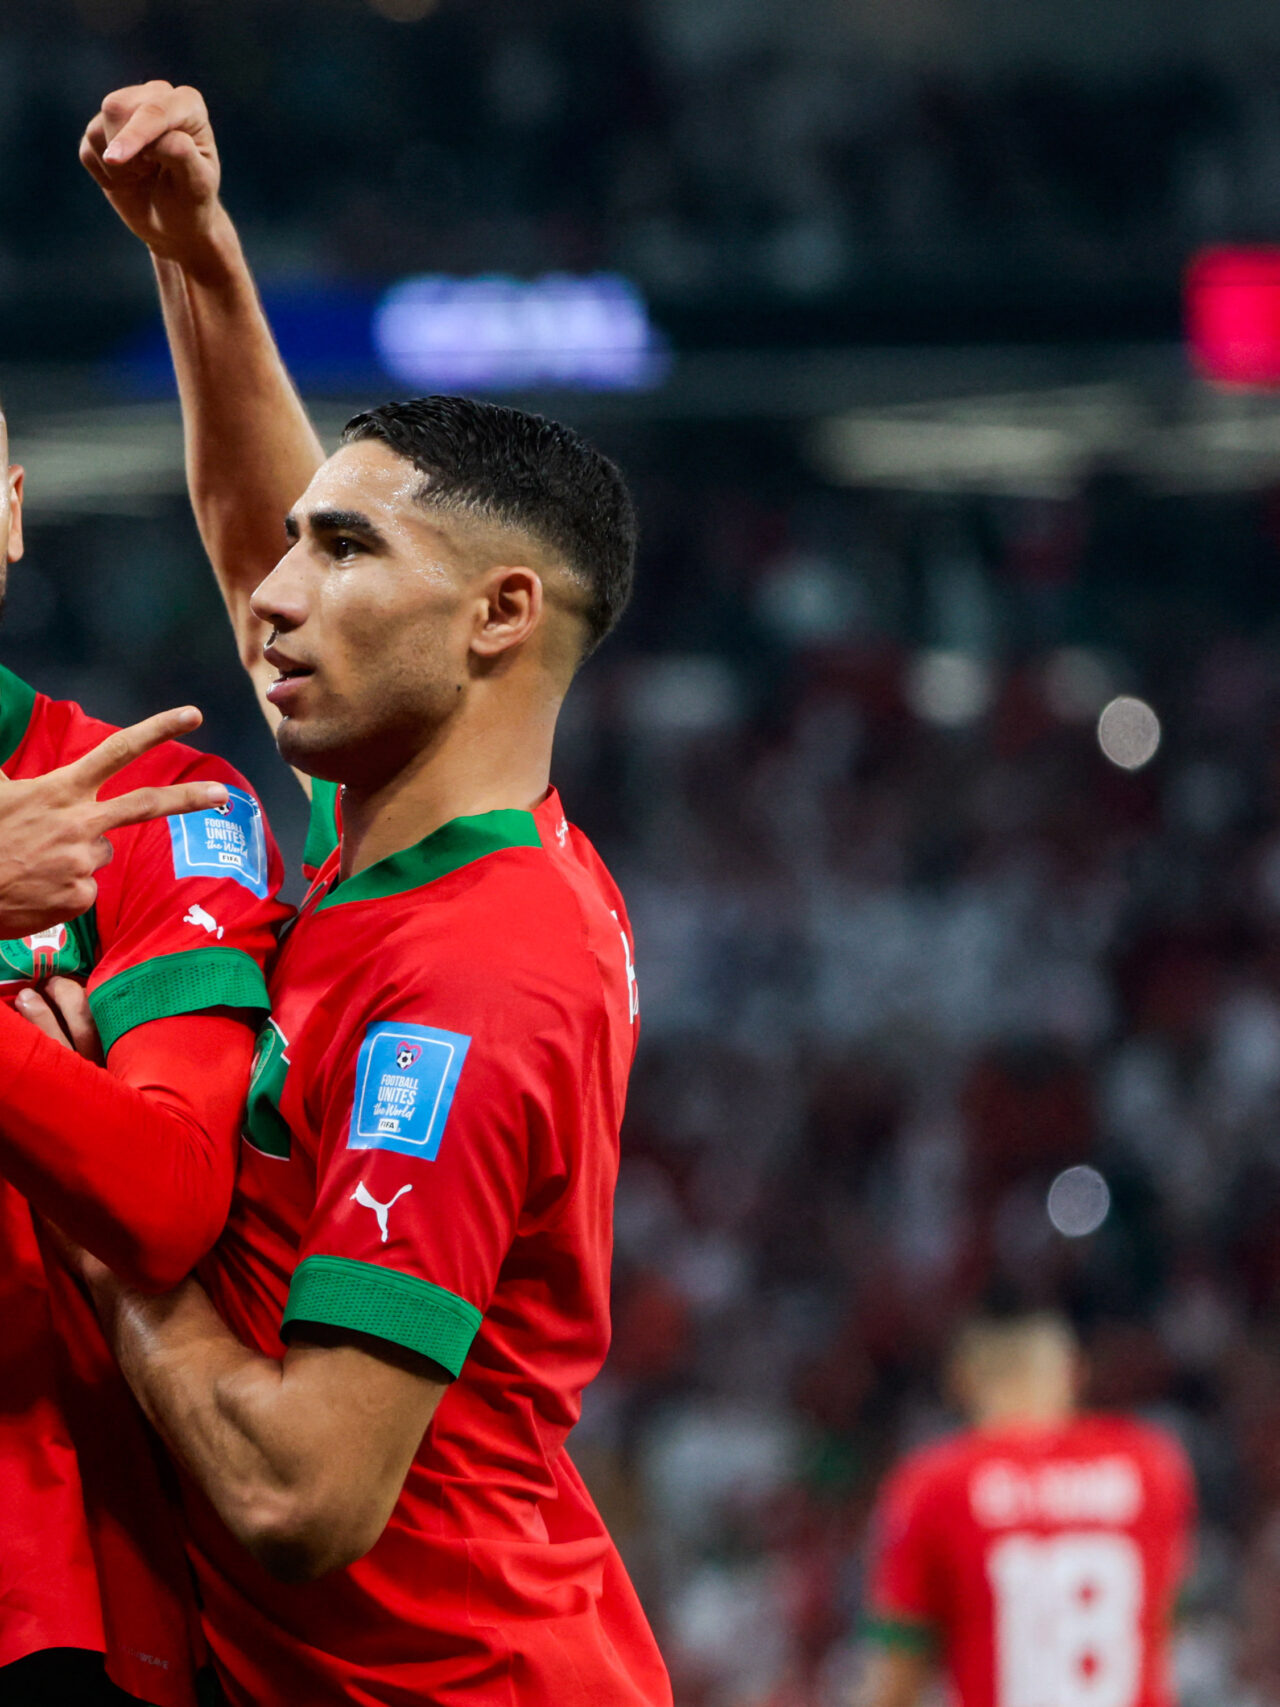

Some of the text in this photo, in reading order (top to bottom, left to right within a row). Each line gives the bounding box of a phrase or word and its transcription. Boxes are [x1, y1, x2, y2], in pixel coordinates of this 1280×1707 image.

[204, 818, 244, 833] FOOTBALL
[206, 827, 246, 847] UNITES
[205, 839, 249, 859] the World
[222, 855, 239, 863] FIFA
[380, 1074, 419, 1090] FOOTBALL
[377, 1086, 417, 1106] UNITES
[373, 1102, 416, 1121] the World
[380, 1120, 396, 1130] FIFA
[984, 1533, 1145, 1707] 18
